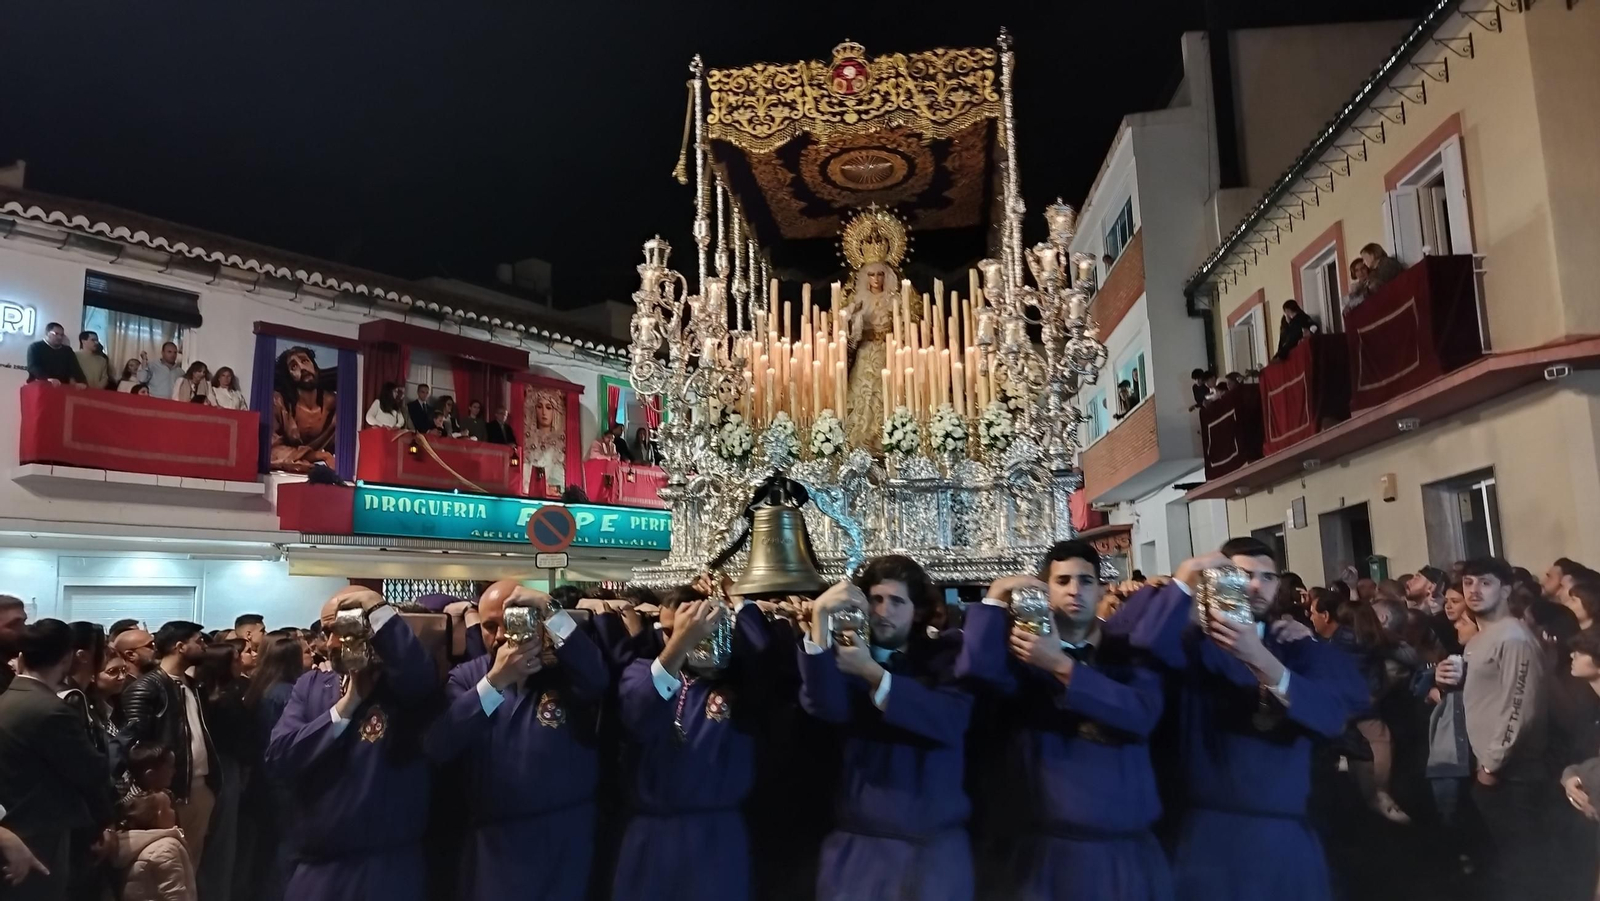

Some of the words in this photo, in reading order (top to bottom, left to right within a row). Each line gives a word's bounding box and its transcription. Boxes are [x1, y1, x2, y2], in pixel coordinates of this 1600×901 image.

[364, 494, 487, 519] DROGUERIA
[516, 507, 620, 533] PPE
[1515, 660, 1530, 695] WALL
[1509, 697, 1523, 722] THE
